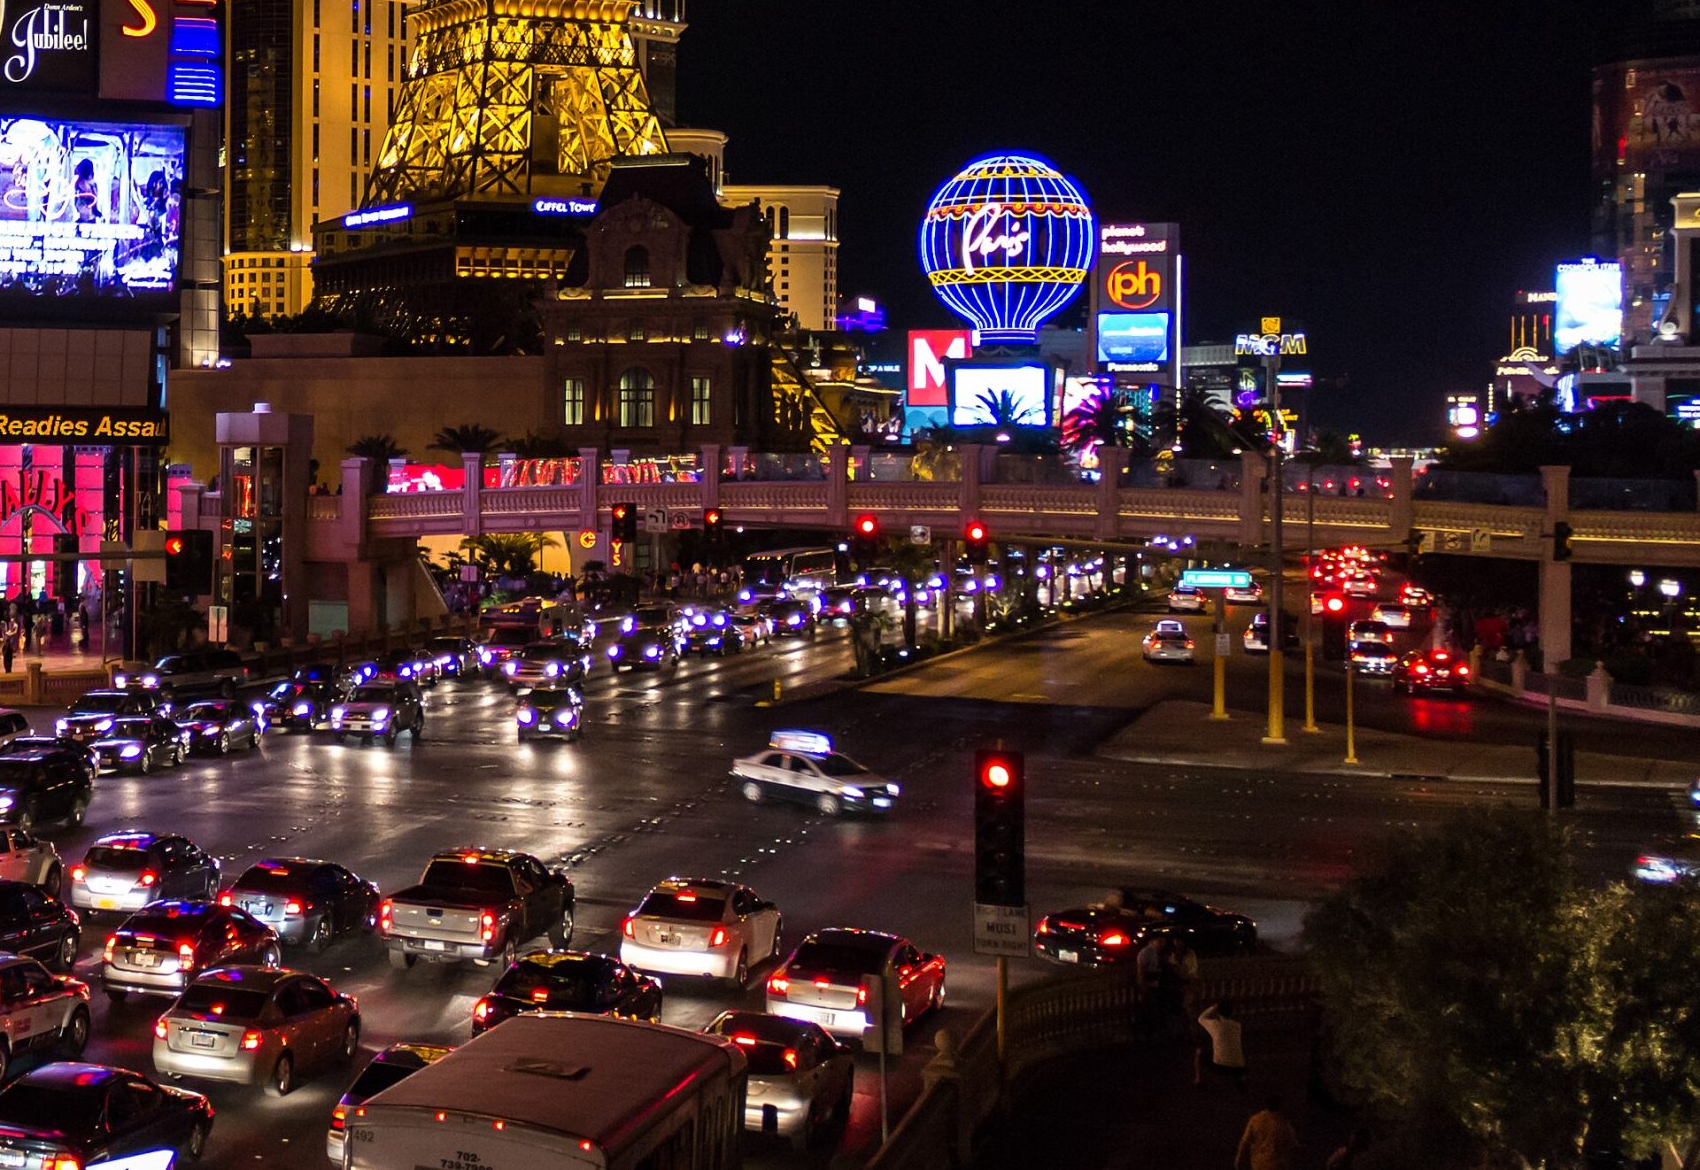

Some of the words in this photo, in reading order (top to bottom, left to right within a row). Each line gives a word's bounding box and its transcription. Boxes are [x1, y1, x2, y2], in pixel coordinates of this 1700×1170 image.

[4, 7, 88, 83] Jubilee!
[1114, 261, 1161, 301] ph
[1235, 334, 1307, 355] MGM
[987, 922, 1016, 935] MUST
